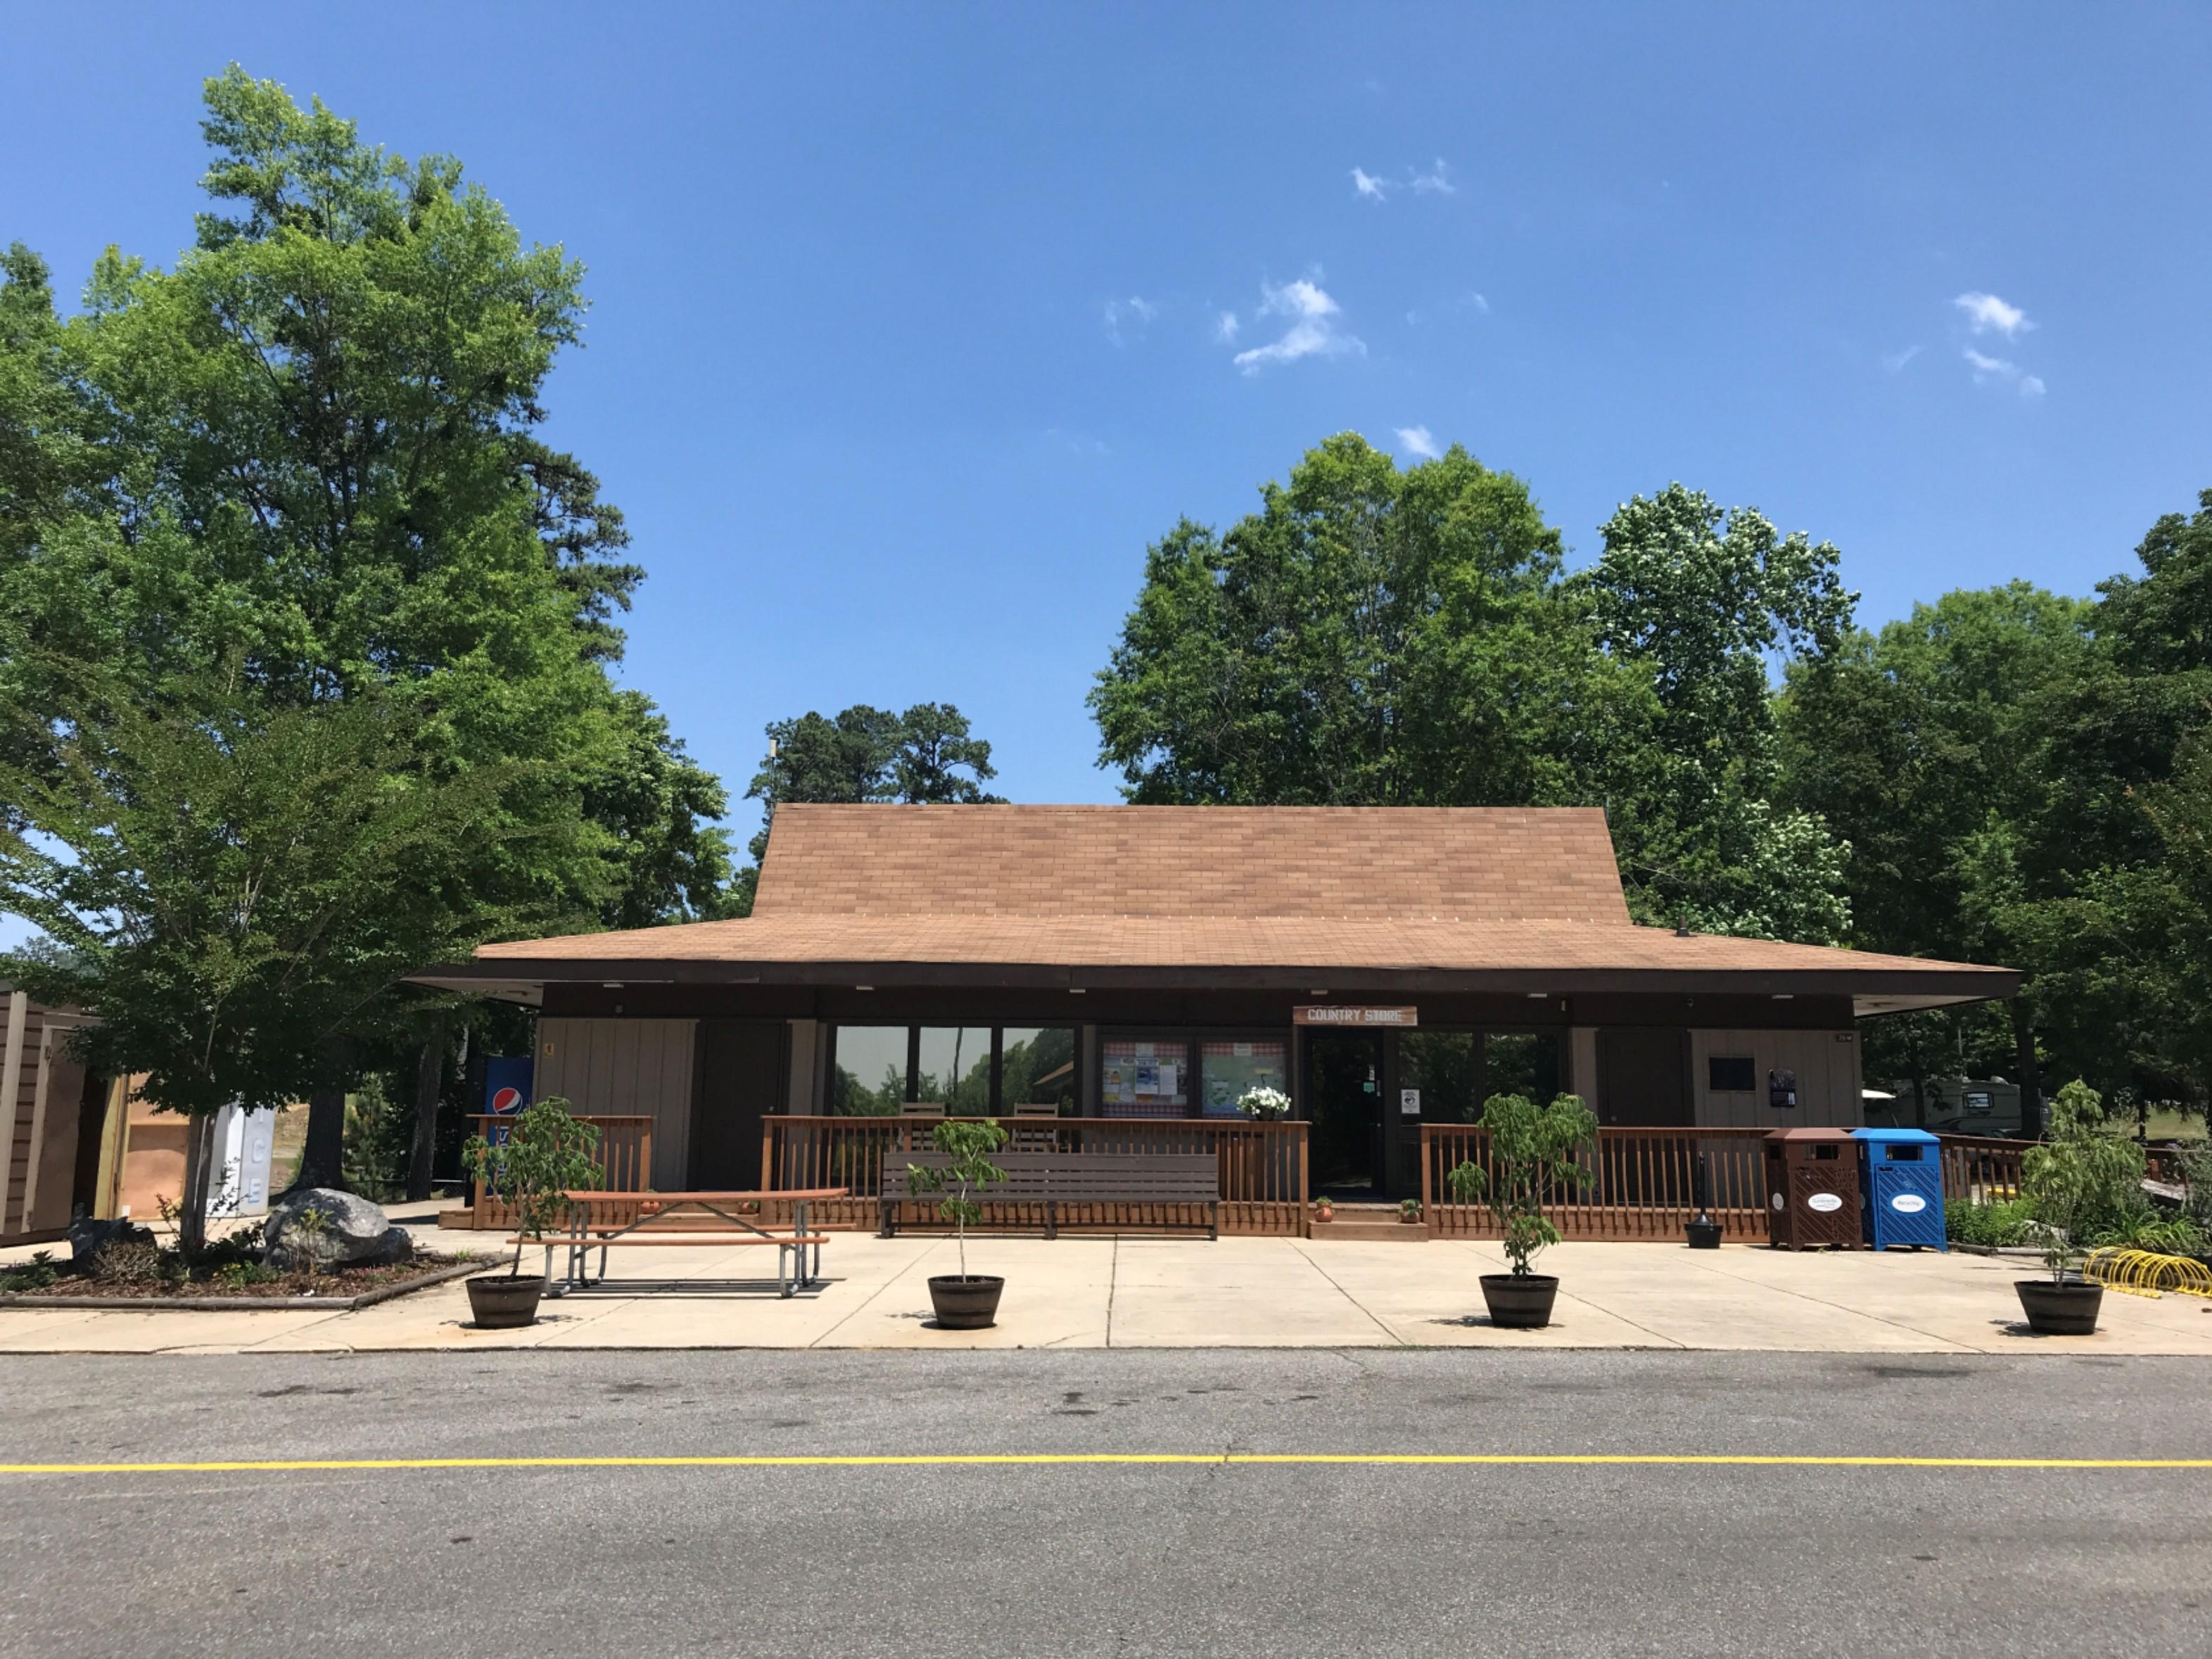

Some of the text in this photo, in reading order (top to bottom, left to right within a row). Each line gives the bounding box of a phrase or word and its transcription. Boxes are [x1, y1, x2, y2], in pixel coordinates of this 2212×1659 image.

[1307, 1009, 1402, 1022] COUNTRY STORE
[248, 1106, 265, 1203] ICE
